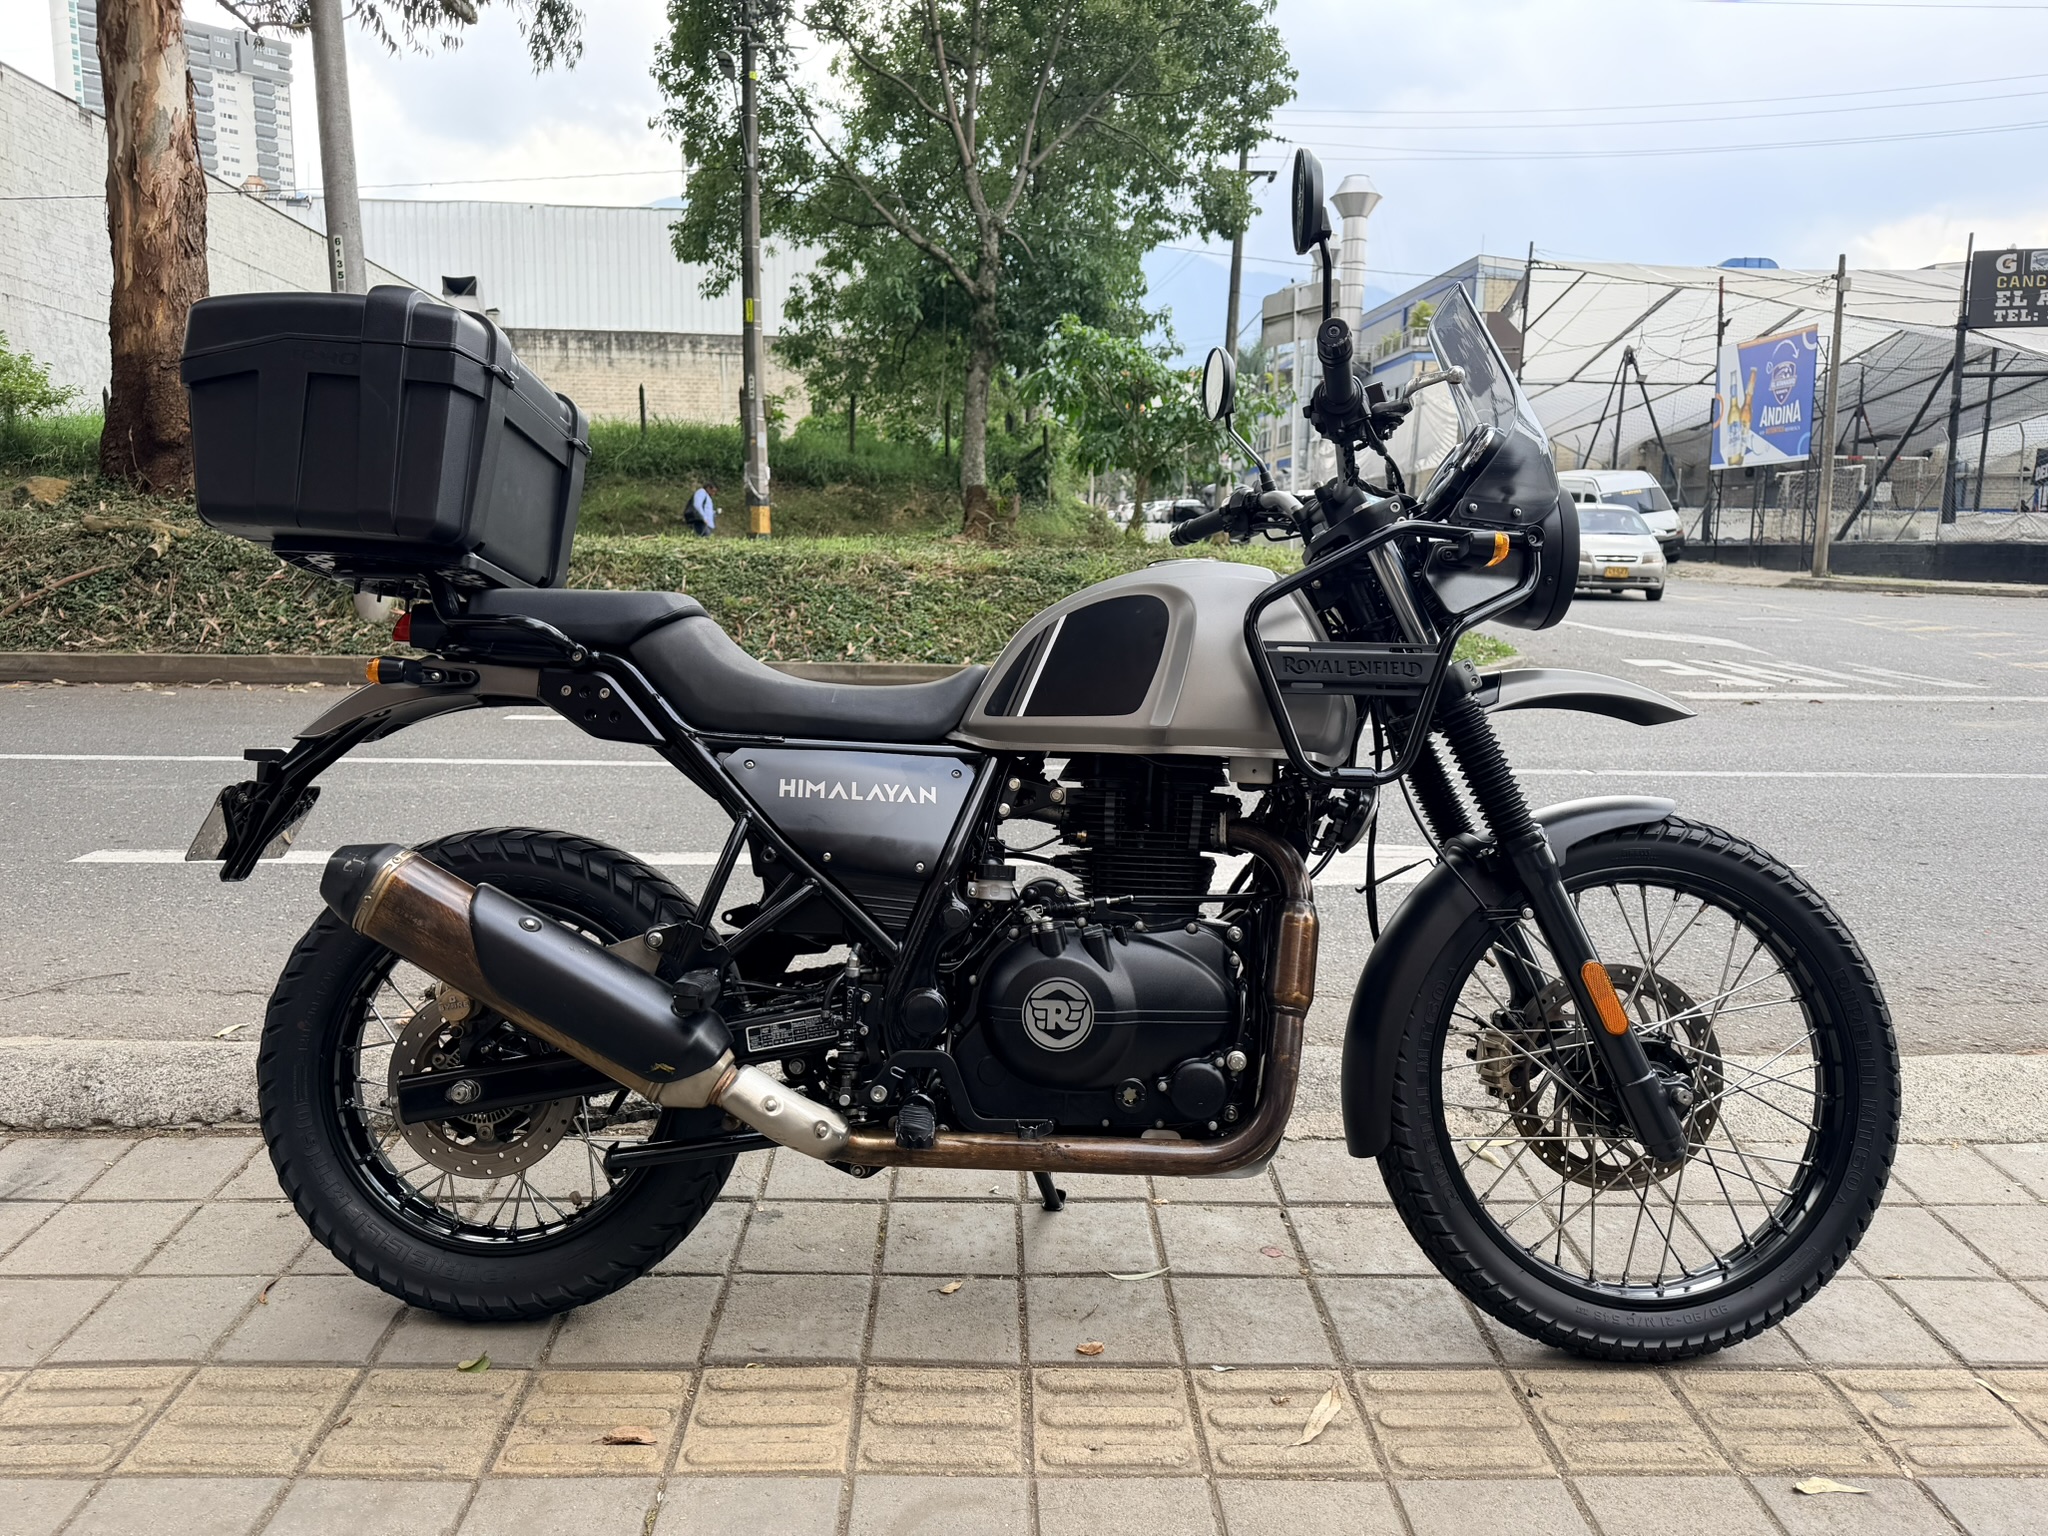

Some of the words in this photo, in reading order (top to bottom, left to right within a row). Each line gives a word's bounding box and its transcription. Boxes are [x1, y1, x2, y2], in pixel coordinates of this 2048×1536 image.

[334, 237, 344, 279] 6135
[1995, 290, 2027, 307] EL
[1994, 309, 2038, 322] TEL:
[1759, 400, 1801, 427] ANDINA
[1282, 656, 1345, 674] ROYAL
[1347, 660, 1423, 677] ENFIELD
[779, 778, 937, 804] HIMALAYAN
[1831, 967, 1878, 1085] PIRELLI
